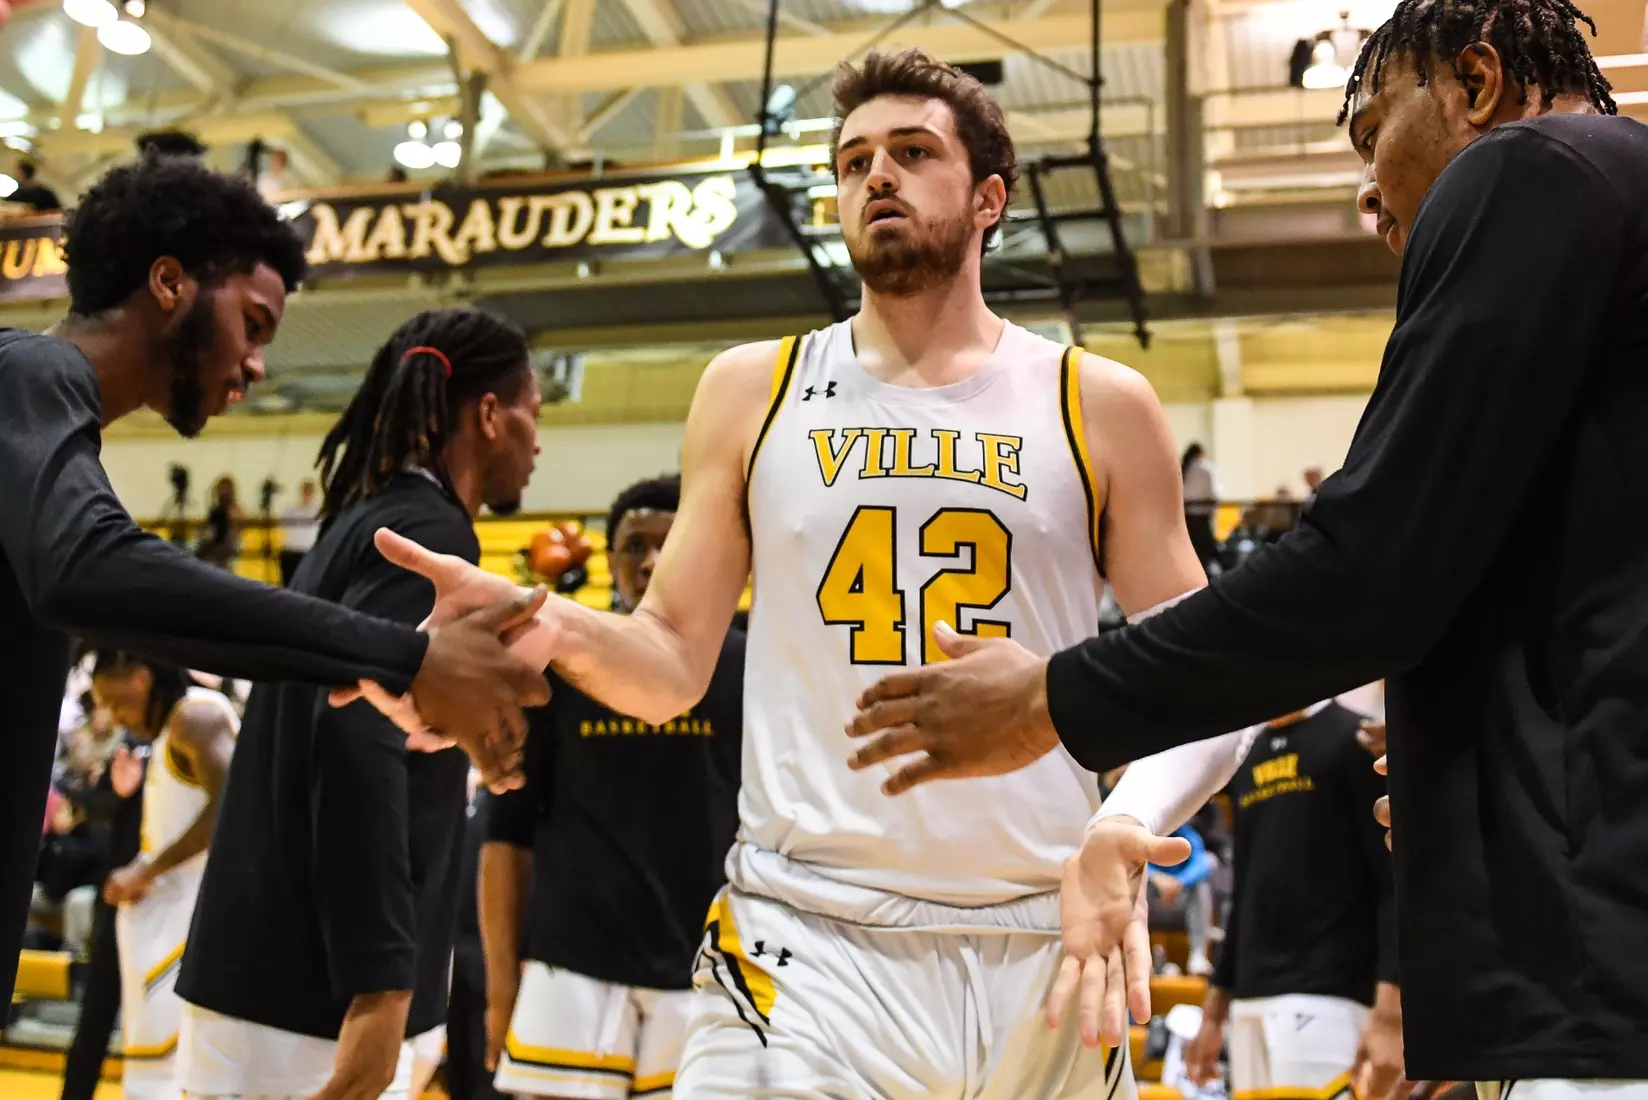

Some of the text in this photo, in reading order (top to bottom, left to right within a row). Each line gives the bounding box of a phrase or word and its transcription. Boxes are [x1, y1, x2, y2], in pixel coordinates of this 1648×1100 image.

[304, 174, 738, 265] MARAUDERS
[808, 427, 1028, 502] VILLE
[816, 505, 1012, 666] 42
